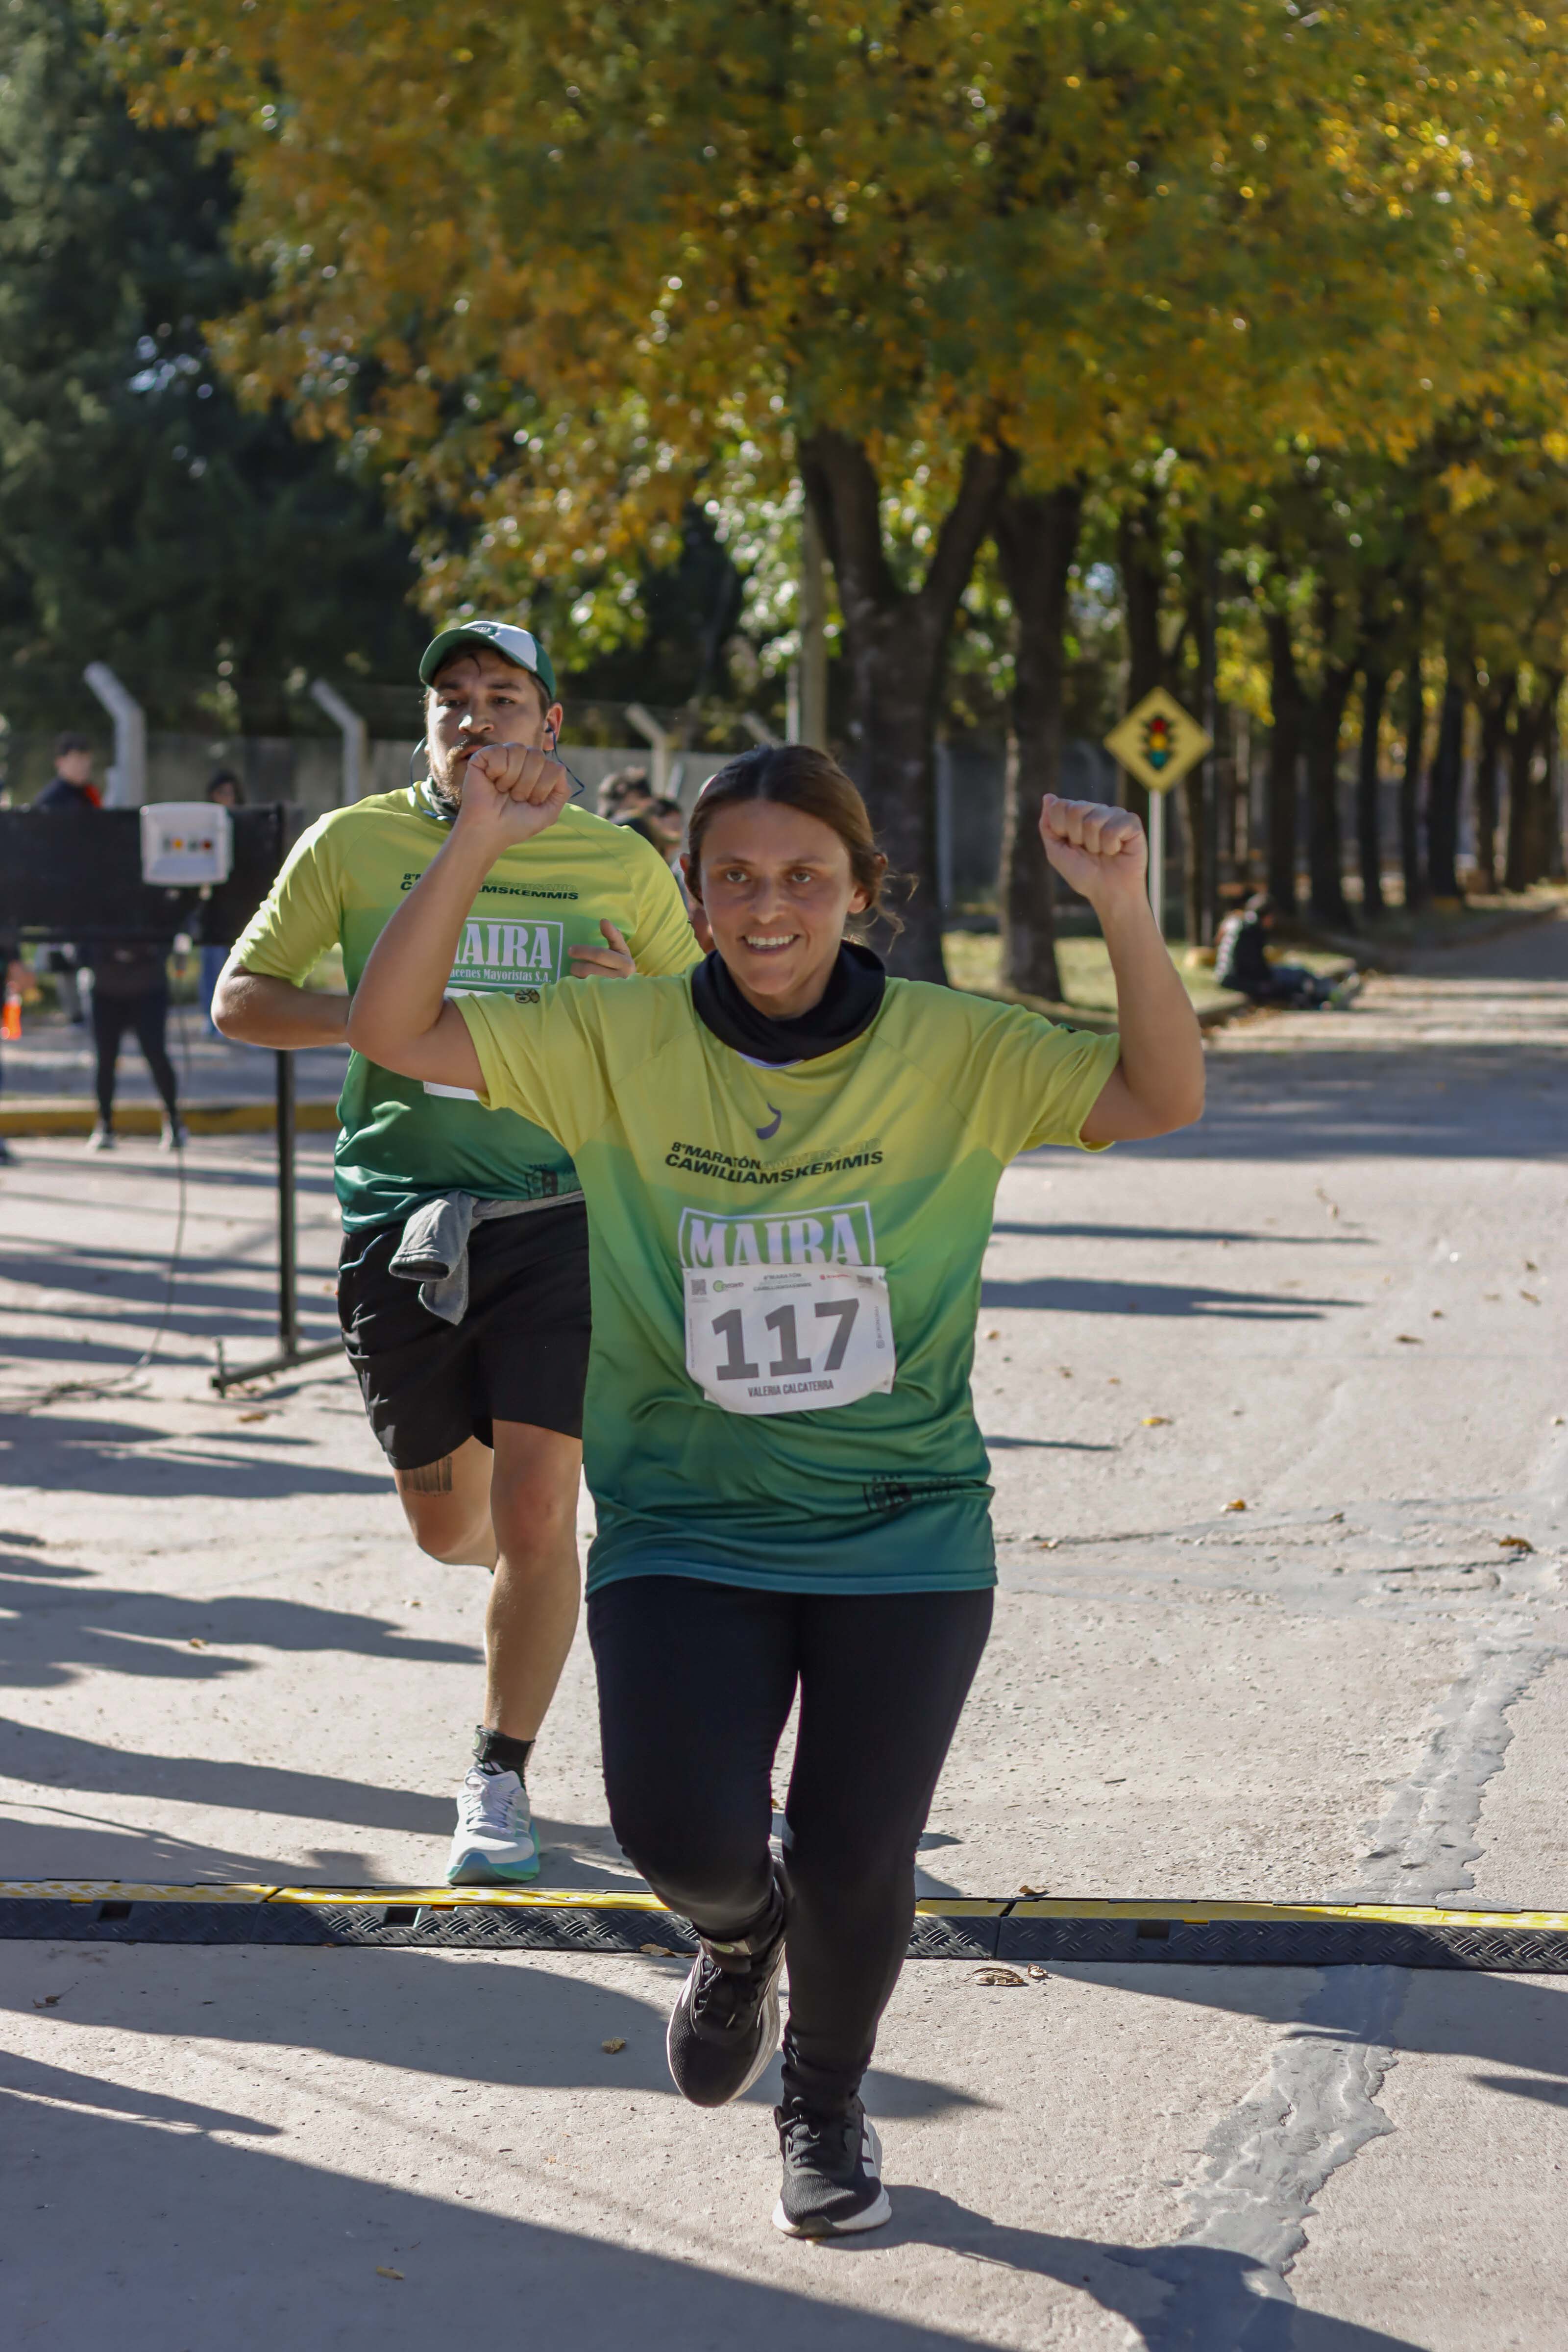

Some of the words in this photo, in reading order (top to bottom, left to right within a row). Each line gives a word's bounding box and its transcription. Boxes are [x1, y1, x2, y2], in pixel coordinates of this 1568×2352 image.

[450, 968, 481, 979] acenes
[484, 969, 533, 981] Mayoristas
[665, 1151, 883, 1184] CAWILLIAMSKEMMIS
[690, 1213, 863, 1268] MAIRA
[711, 1298, 860, 1381] 117
[748, 1384, 782, 1397] VALERIA
[783, 1379, 834, 1395] CALCATERRA
